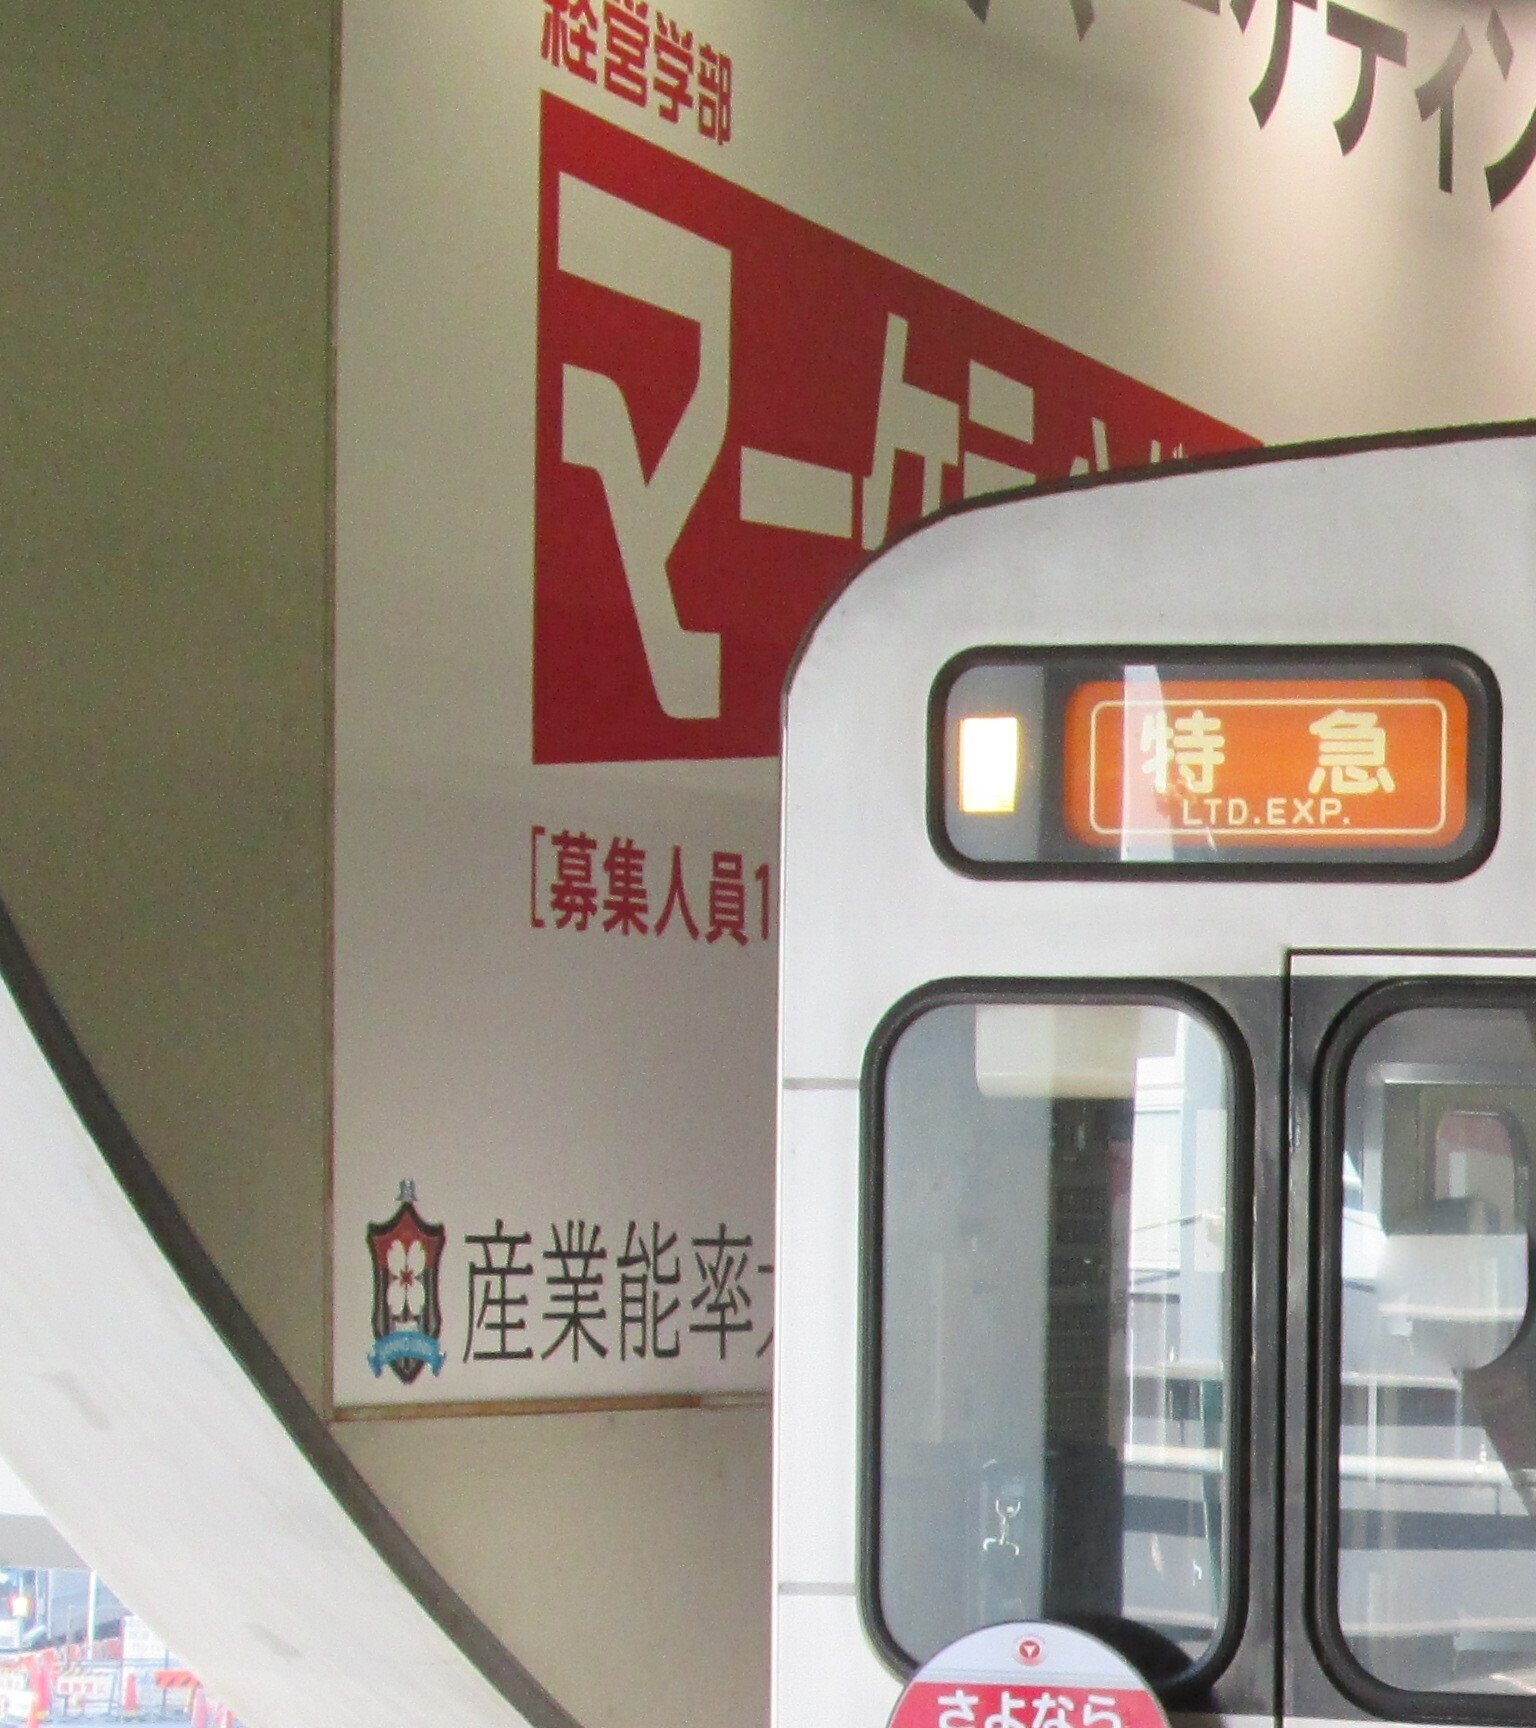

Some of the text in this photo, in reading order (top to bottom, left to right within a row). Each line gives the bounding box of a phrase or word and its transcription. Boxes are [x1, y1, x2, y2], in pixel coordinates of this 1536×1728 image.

[539, 0, 732, 146] 経営学部
[1140, 708, 1396, 796] 特急
